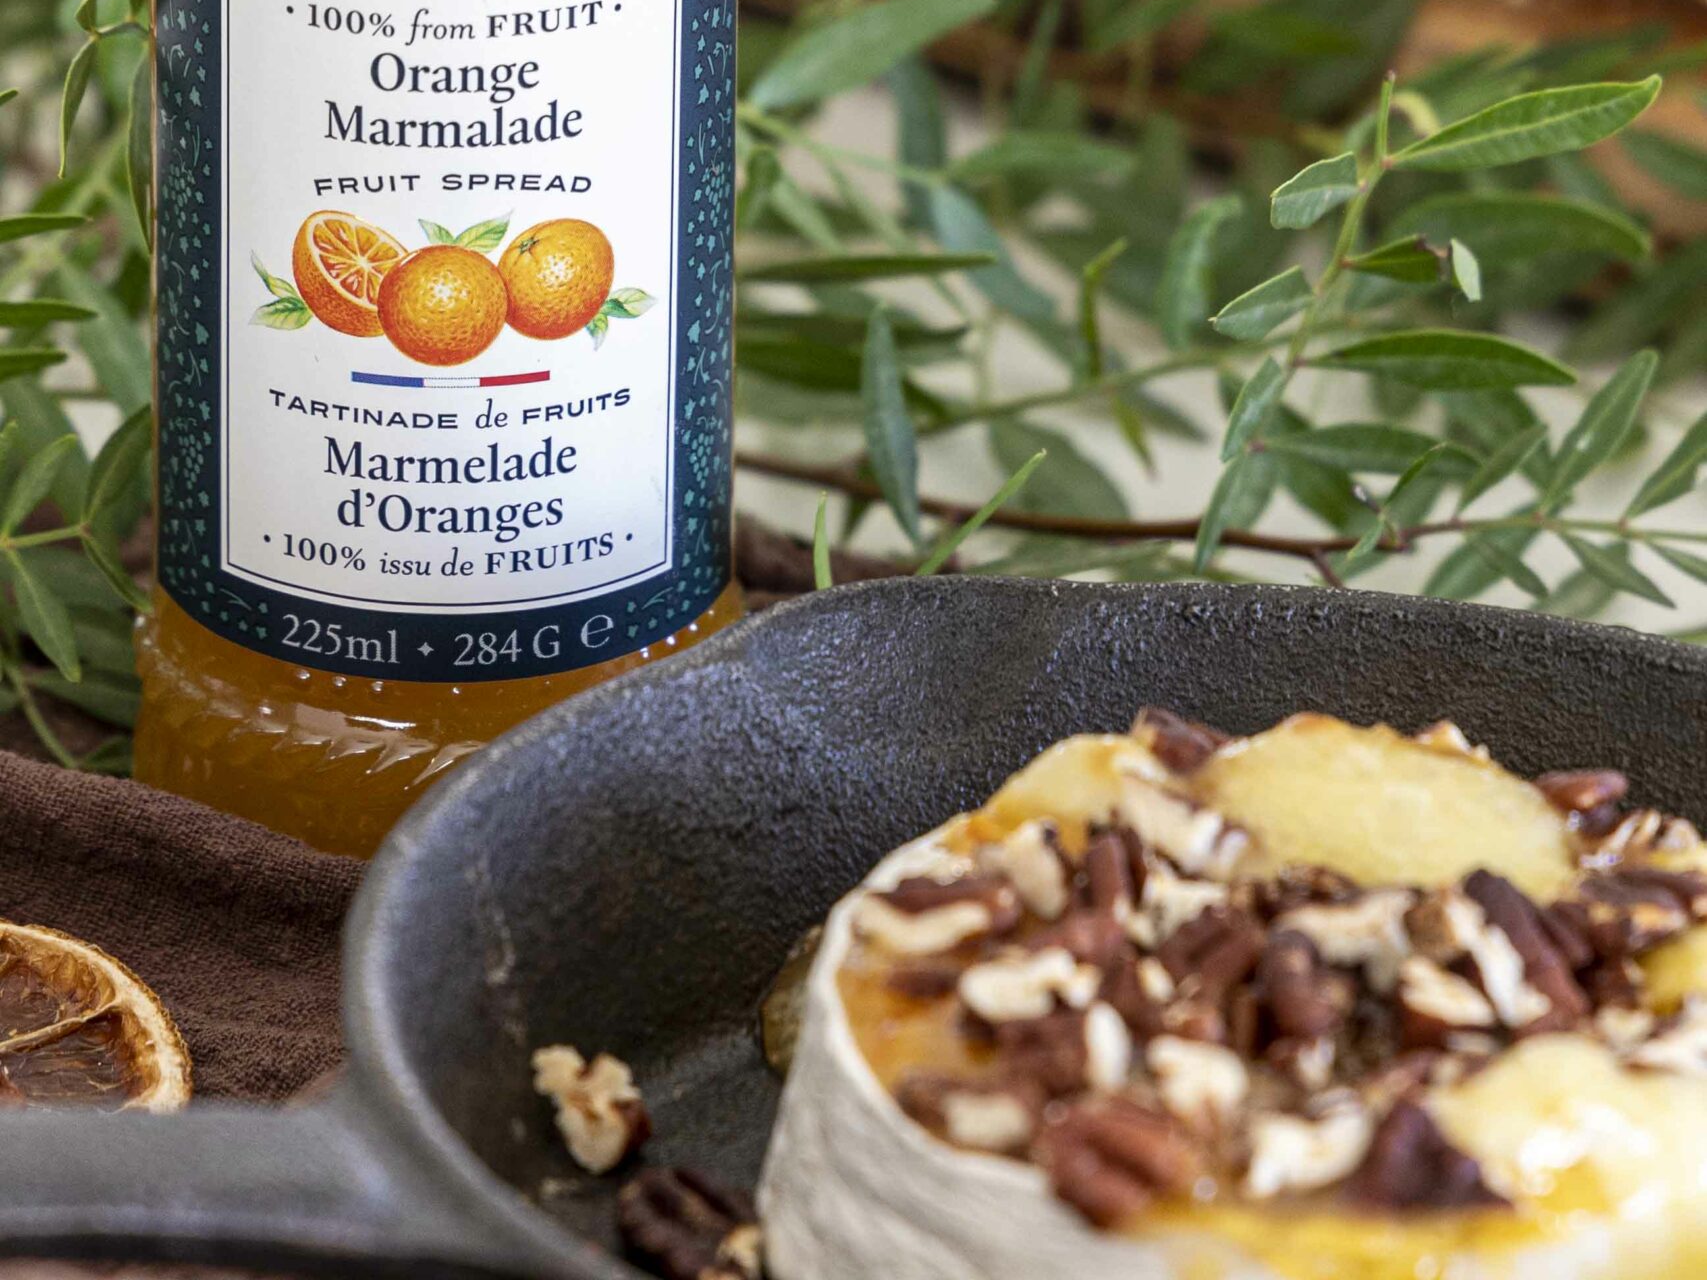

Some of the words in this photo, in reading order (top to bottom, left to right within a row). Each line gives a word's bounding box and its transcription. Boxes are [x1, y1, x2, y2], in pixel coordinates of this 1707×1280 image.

[306, 3, 395, 37] 100%
[404, 8, 476, 45] from
[486, 1, 603, 37] FRUIT
[369, 53, 540, 104] Orange
[323, 100, 583, 149] Marmalade
[313, 175, 421, 196] FRUIT
[442, 174, 592, 193] SPREAD
[269, 388, 458, 429] TARTINADE
[475, 399, 508, 429] de
[522, 388, 631, 425] FRUITS
[323, 436, 577, 484] Marmelade
[336, 489, 563, 542] d'Oranges
[283, 533, 366, 572] 100%
[380, 547, 430, 575] issu
[440, 547, 474, 577] de
[484, 532, 614, 574] FRUITS
[280, 614, 400, 664] 225ml
[453, 628, 522, 667] 284
[532, 624, 561, 658] G
